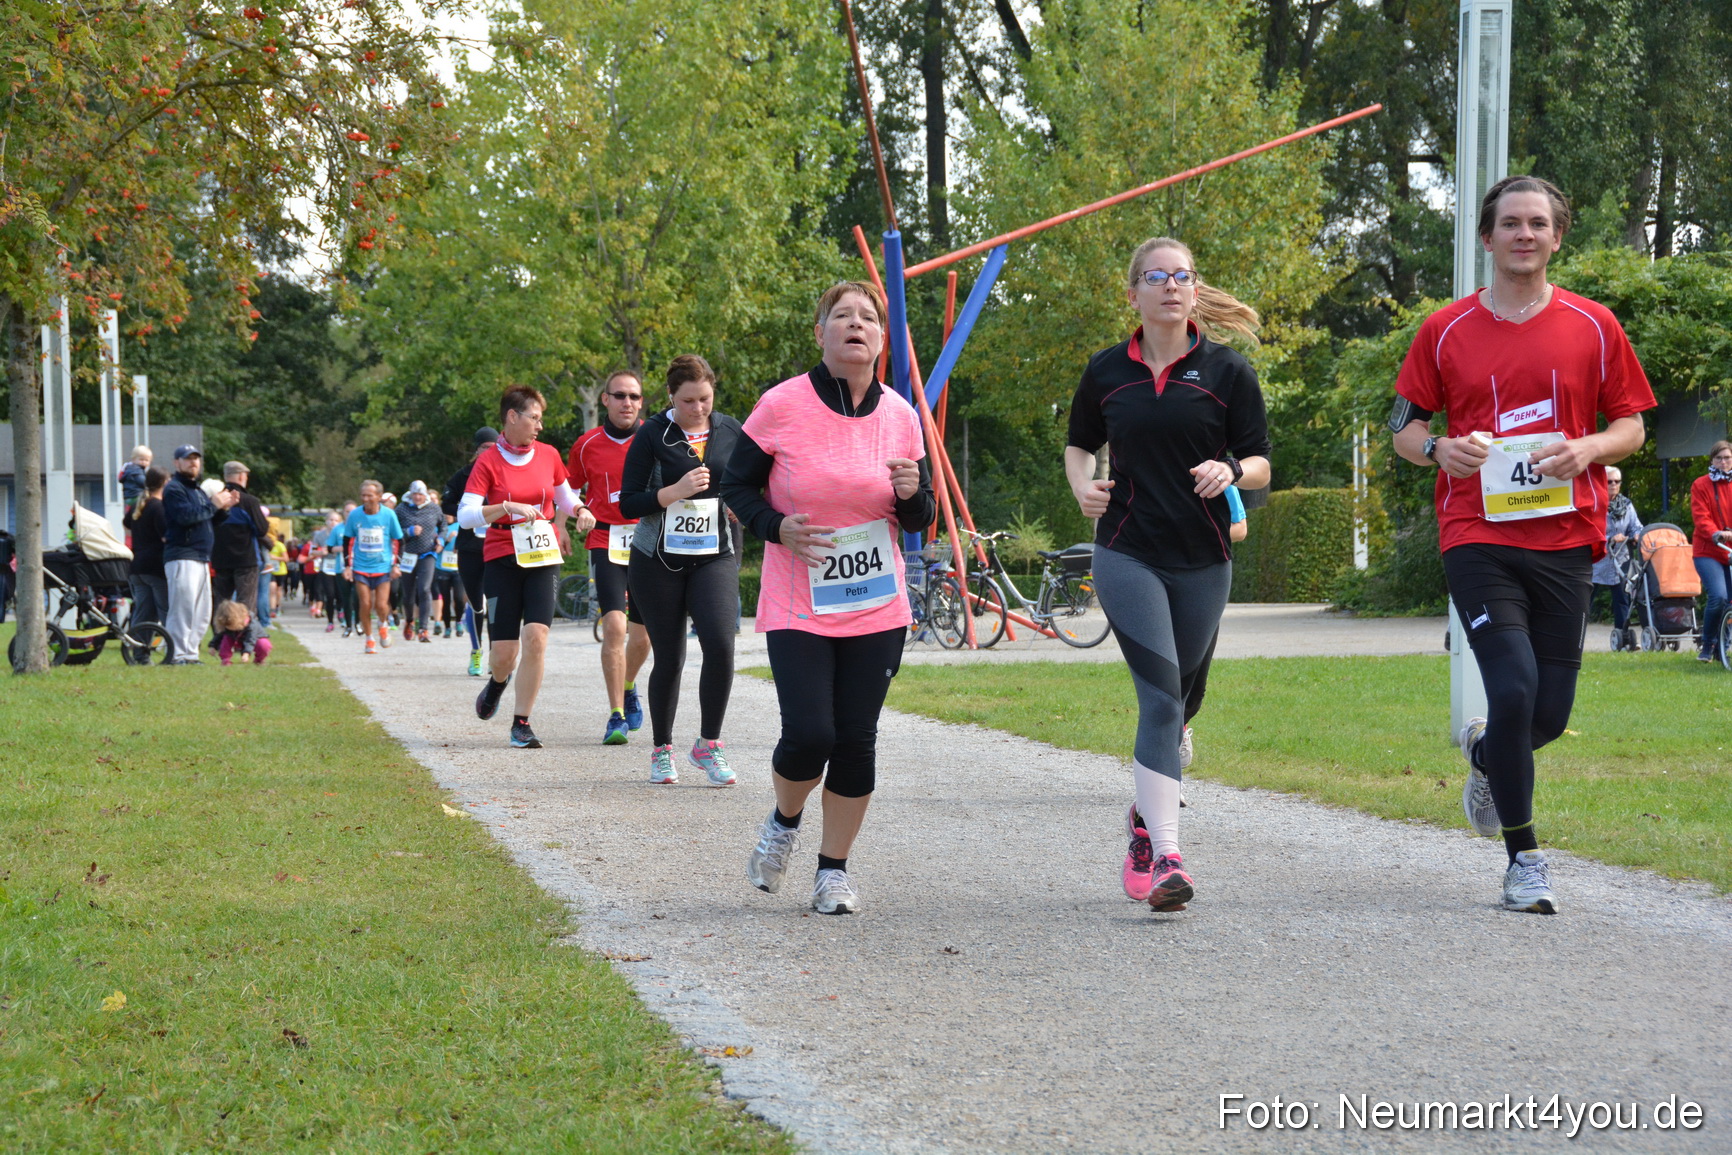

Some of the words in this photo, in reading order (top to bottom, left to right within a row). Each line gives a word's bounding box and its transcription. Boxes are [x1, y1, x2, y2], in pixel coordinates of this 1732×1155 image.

[1514, 408, 1538, 422] DEHN
[1507, 493, 1550, 506] Christoph
[674, 516, 710, 533] 2621
[525, 534, 551, 549] 125
[840, 531, 869, 543] BOCK
[822, 547, 883, 580] 2084
[845, 586, 868, 597] Petra
